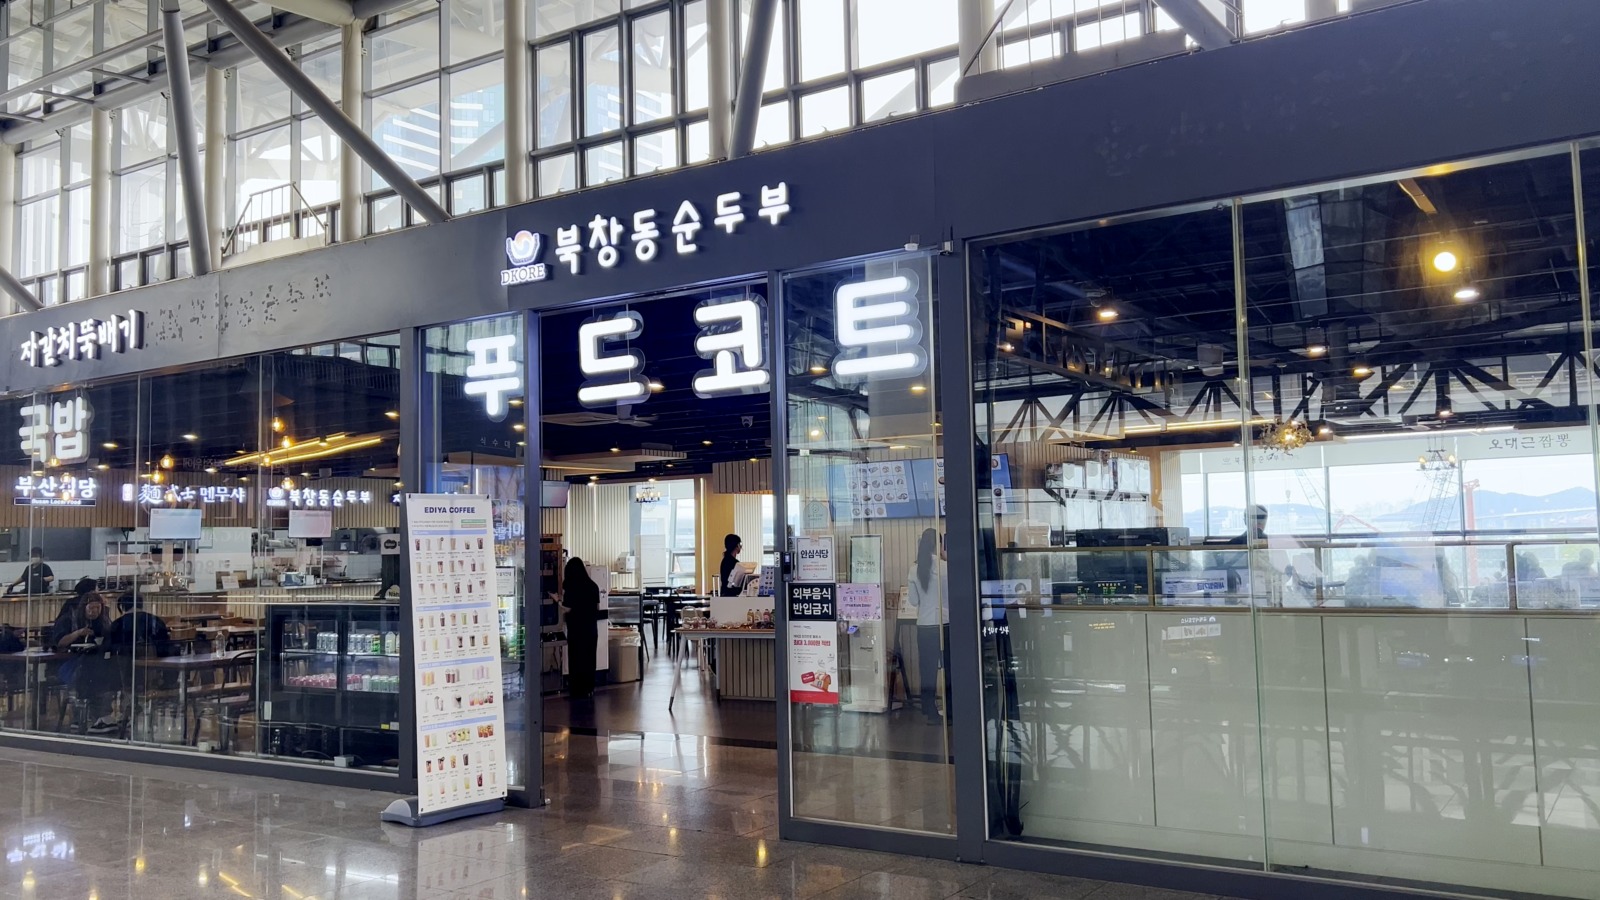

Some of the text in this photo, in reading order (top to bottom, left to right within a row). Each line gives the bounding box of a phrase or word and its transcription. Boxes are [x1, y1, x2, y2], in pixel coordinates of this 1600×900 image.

[555, 181, 792, 275] 북창동순두부
[501, 266, 546, 286] DKORE
[20, 308, 138, 367] 자갈치뚝배기
[463, 275, 920, 416] 푸드코트
[288, 487, 371, 507] 북창동순두부
[800, 549, 829, 559] 안심식당
[792, 587, 832, 600] 외부음식
[792, 602, 832, 616] 반입금지
